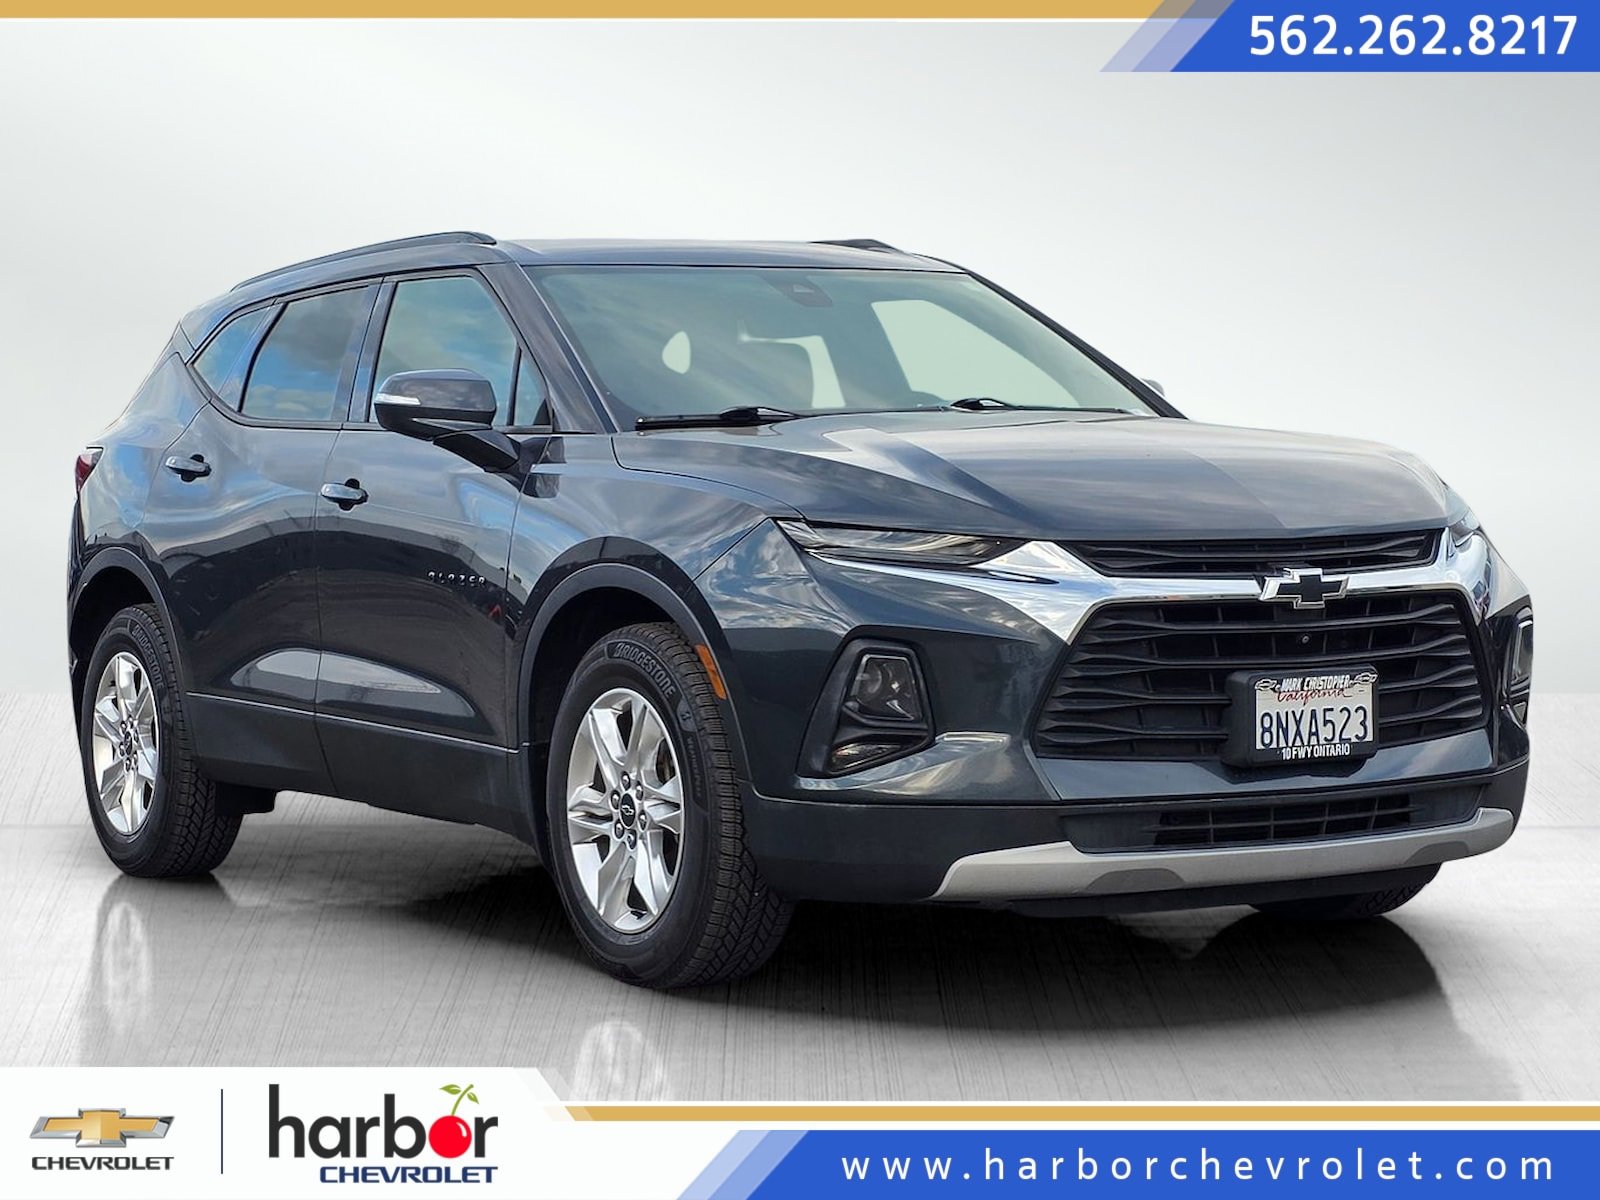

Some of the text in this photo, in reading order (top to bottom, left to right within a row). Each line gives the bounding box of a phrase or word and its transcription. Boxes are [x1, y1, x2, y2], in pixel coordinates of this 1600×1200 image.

[613, 642, 676, 698] BRIDGESTONE
[1281, 676, 1302, 691] MARK
[1260, 705, 1368, 749] 8NXA523
[1281, 743, 1350, 760] 10 FWY ONTARIO
